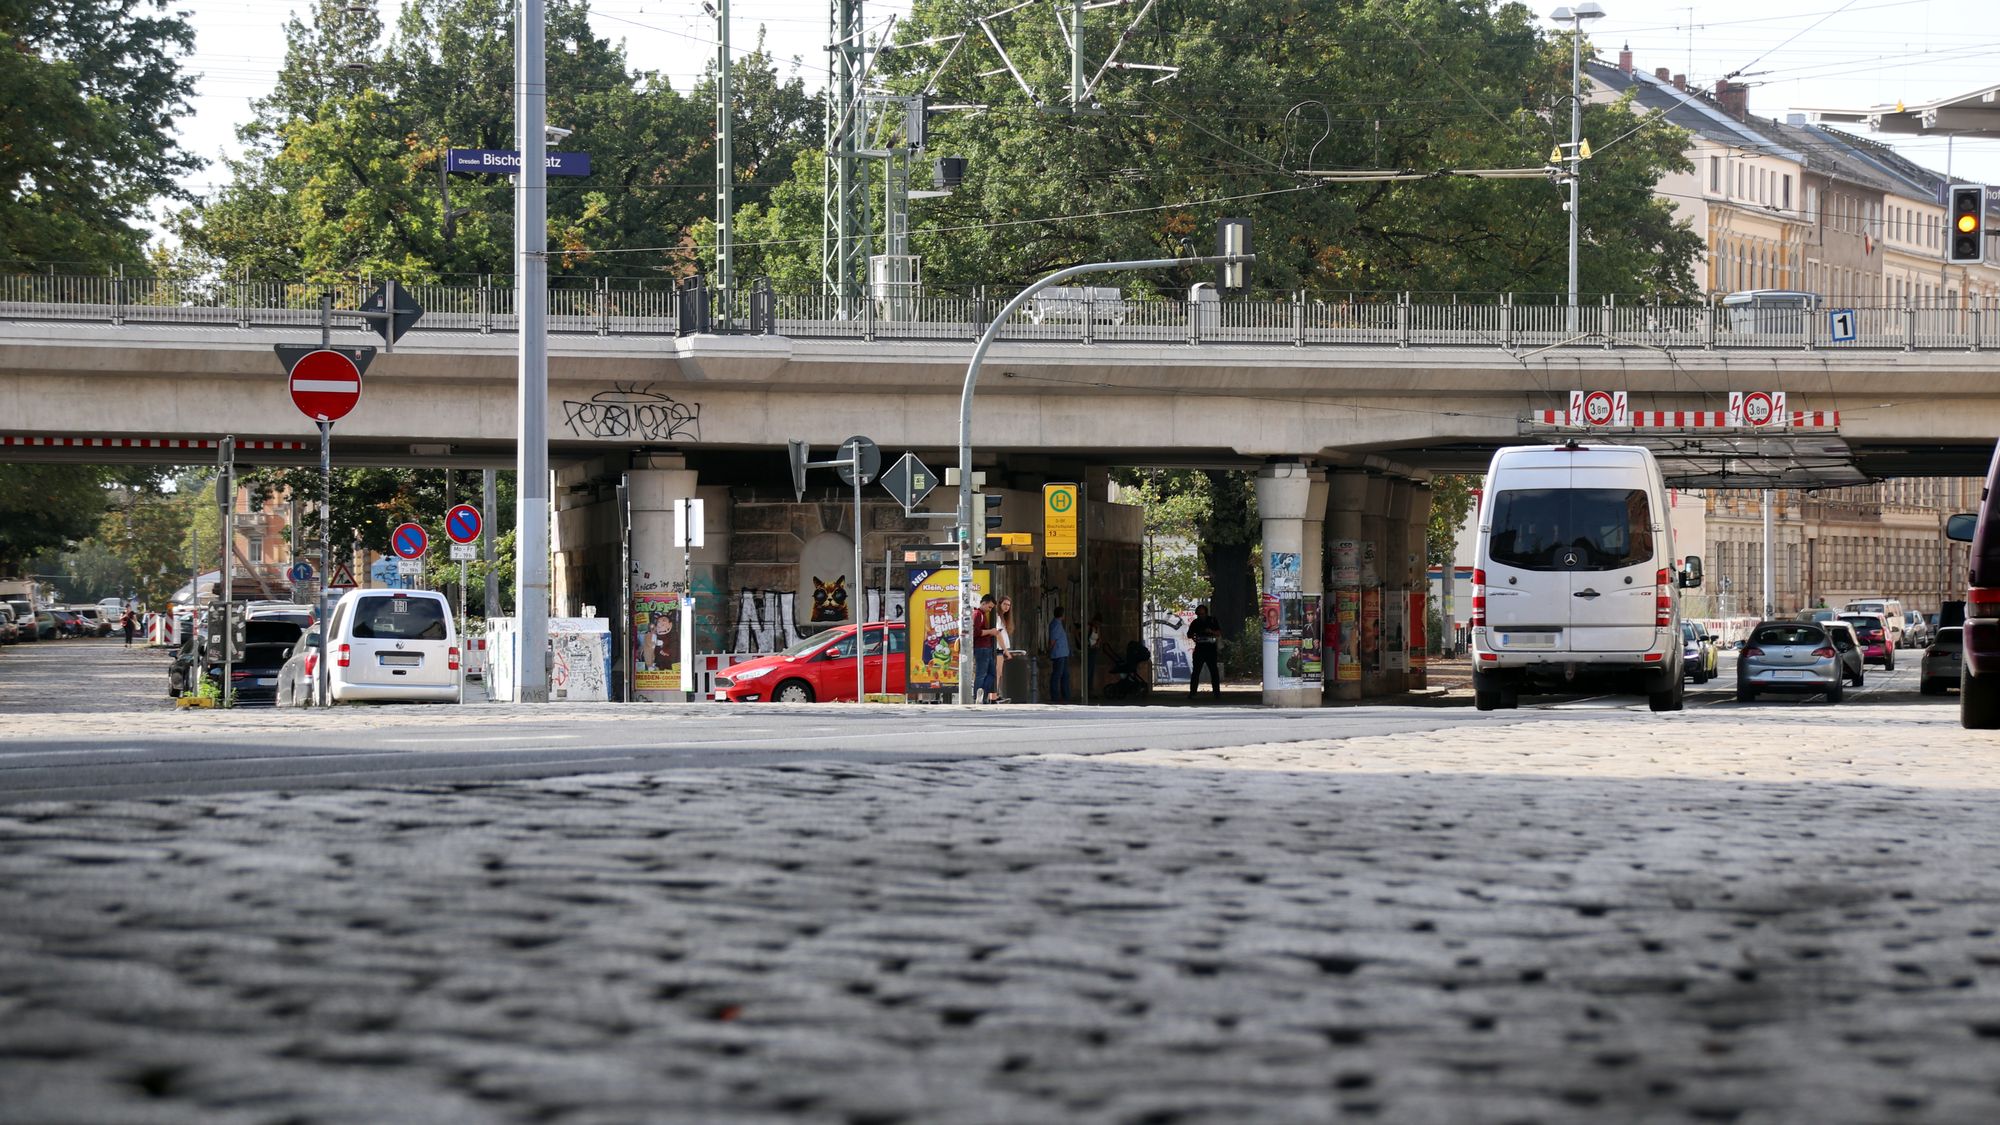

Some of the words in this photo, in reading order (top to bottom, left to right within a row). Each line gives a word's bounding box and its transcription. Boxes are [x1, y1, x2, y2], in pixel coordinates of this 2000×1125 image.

[483, 153, 562, 168] Bischoatz
[1837, 314, 1848, 336] 1
[911, 570, 928, 587] NEU
[922, 584, 944, 592] Klein,
